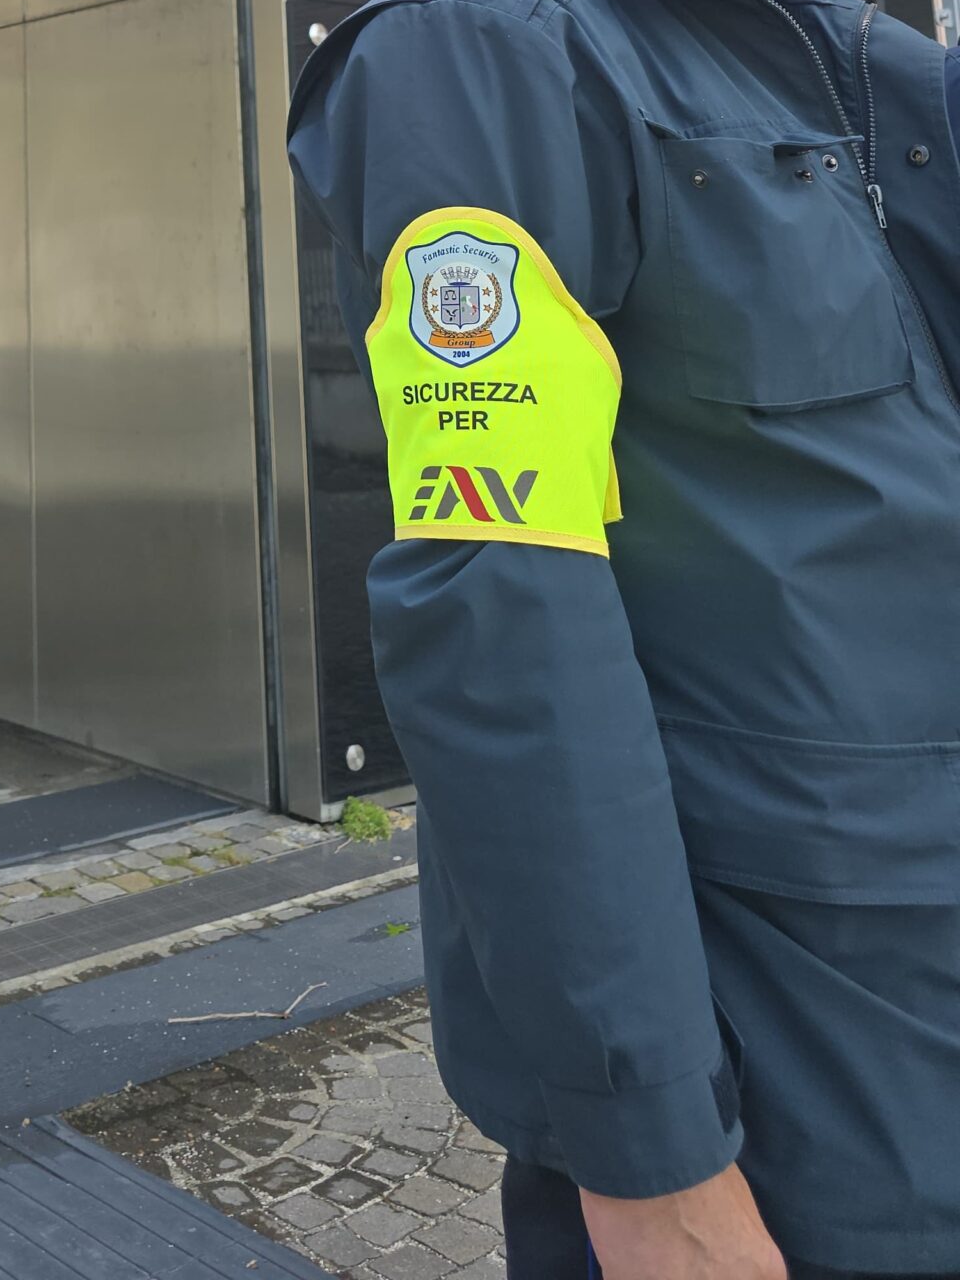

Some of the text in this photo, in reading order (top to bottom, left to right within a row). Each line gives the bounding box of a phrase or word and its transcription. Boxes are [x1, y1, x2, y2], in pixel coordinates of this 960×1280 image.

[421, 243, 501, 265] Fantastic Security
[446, 337, 476, 349] Group
[402, 381, 538, 405] SICUREZZA
[438, 410, 489, 431] PER
[408, 465, 539, 525] EAV
